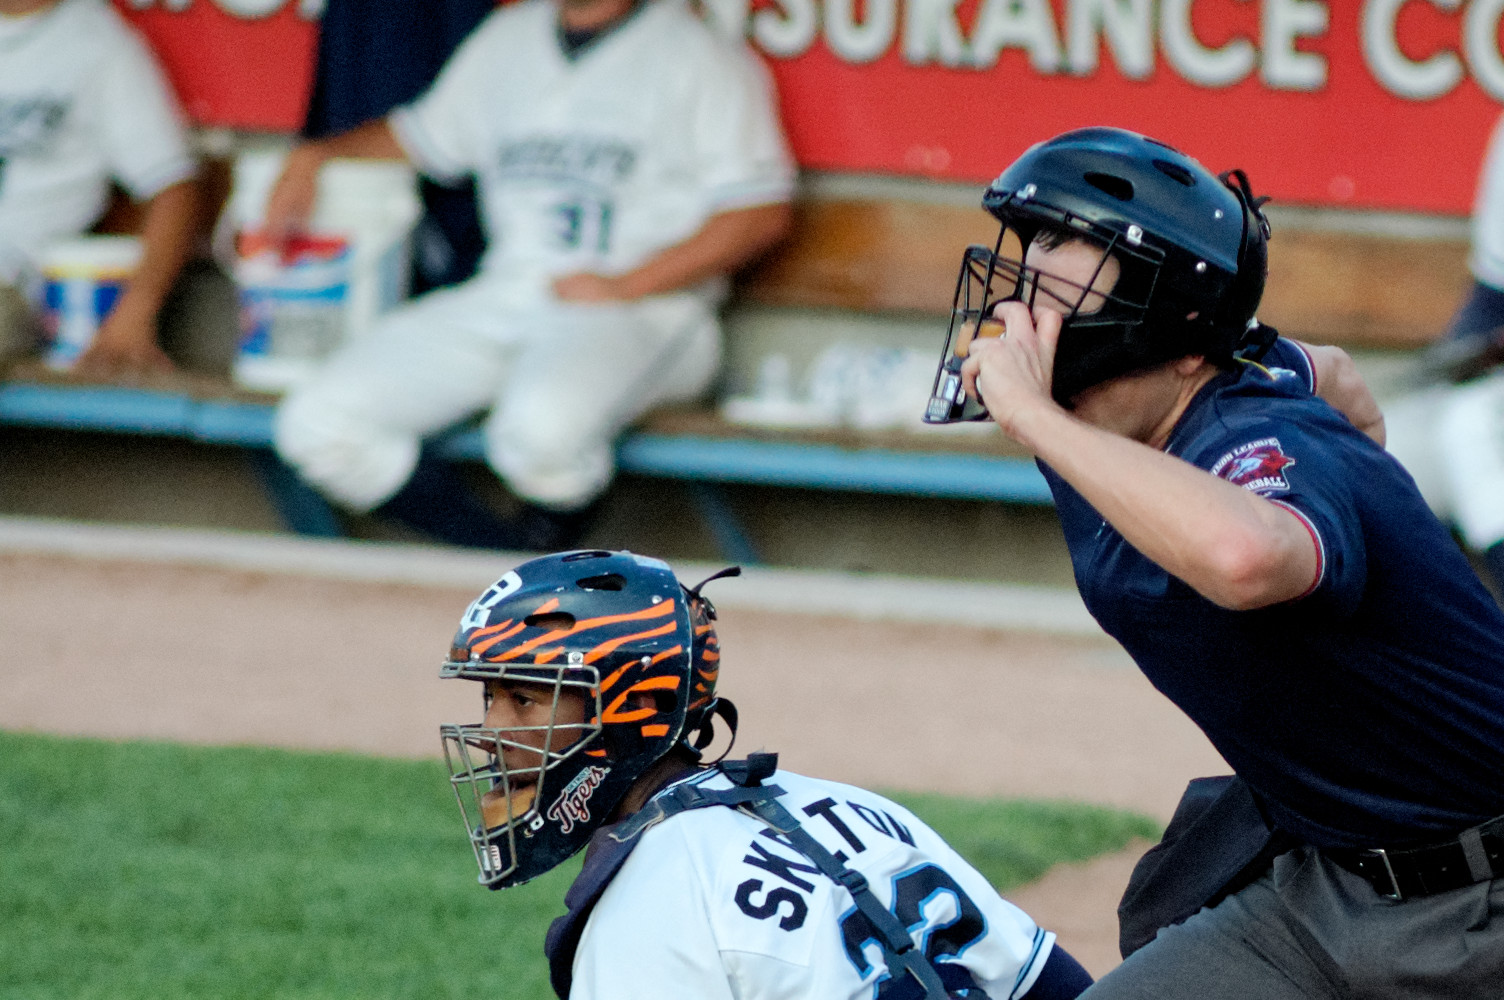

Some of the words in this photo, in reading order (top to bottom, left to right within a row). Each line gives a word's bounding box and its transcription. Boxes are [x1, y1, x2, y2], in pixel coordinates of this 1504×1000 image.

[694, 0, 1330, 92] SURANCE
[547, 765, 606, 835] Tigers
[734, 796, 918, 932] SKTON
